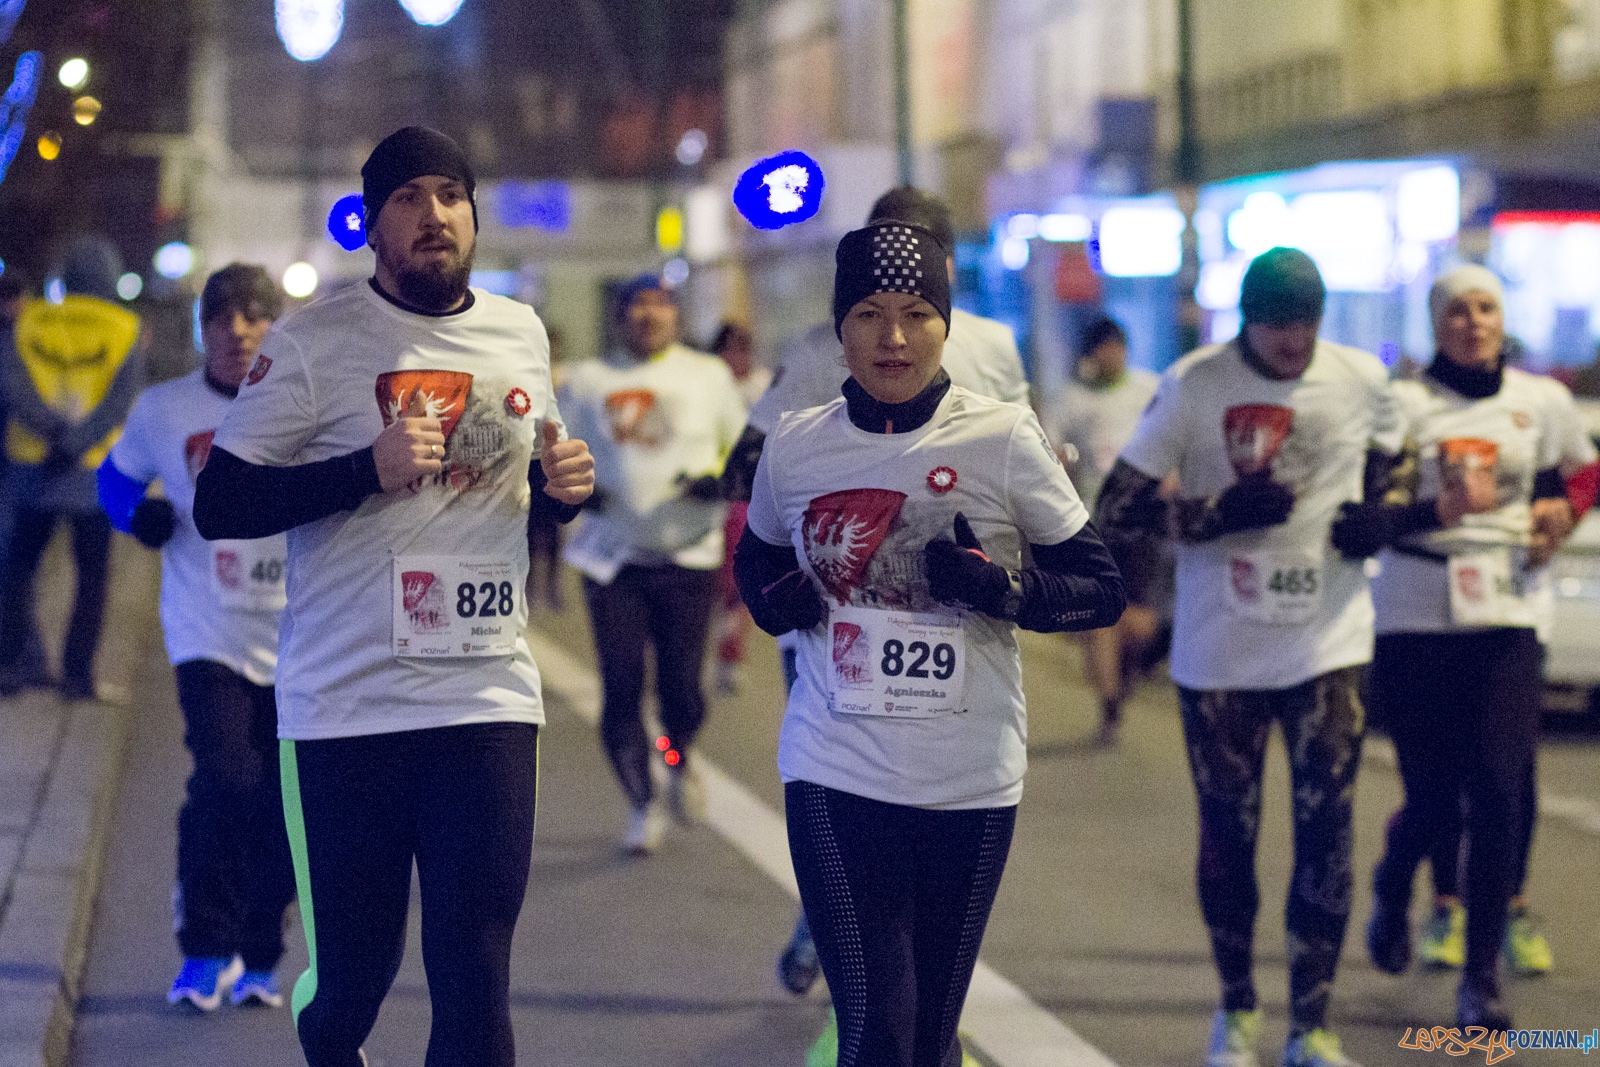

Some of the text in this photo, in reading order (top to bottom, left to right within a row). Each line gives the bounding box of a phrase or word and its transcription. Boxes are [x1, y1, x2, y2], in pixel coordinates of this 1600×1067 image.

[1268, 568, 1317, 595] 465
[456, 581, 513, 618] 828
[881, 639, 956, 680] 829
[884, 686, 947, 698] Agnieszka
